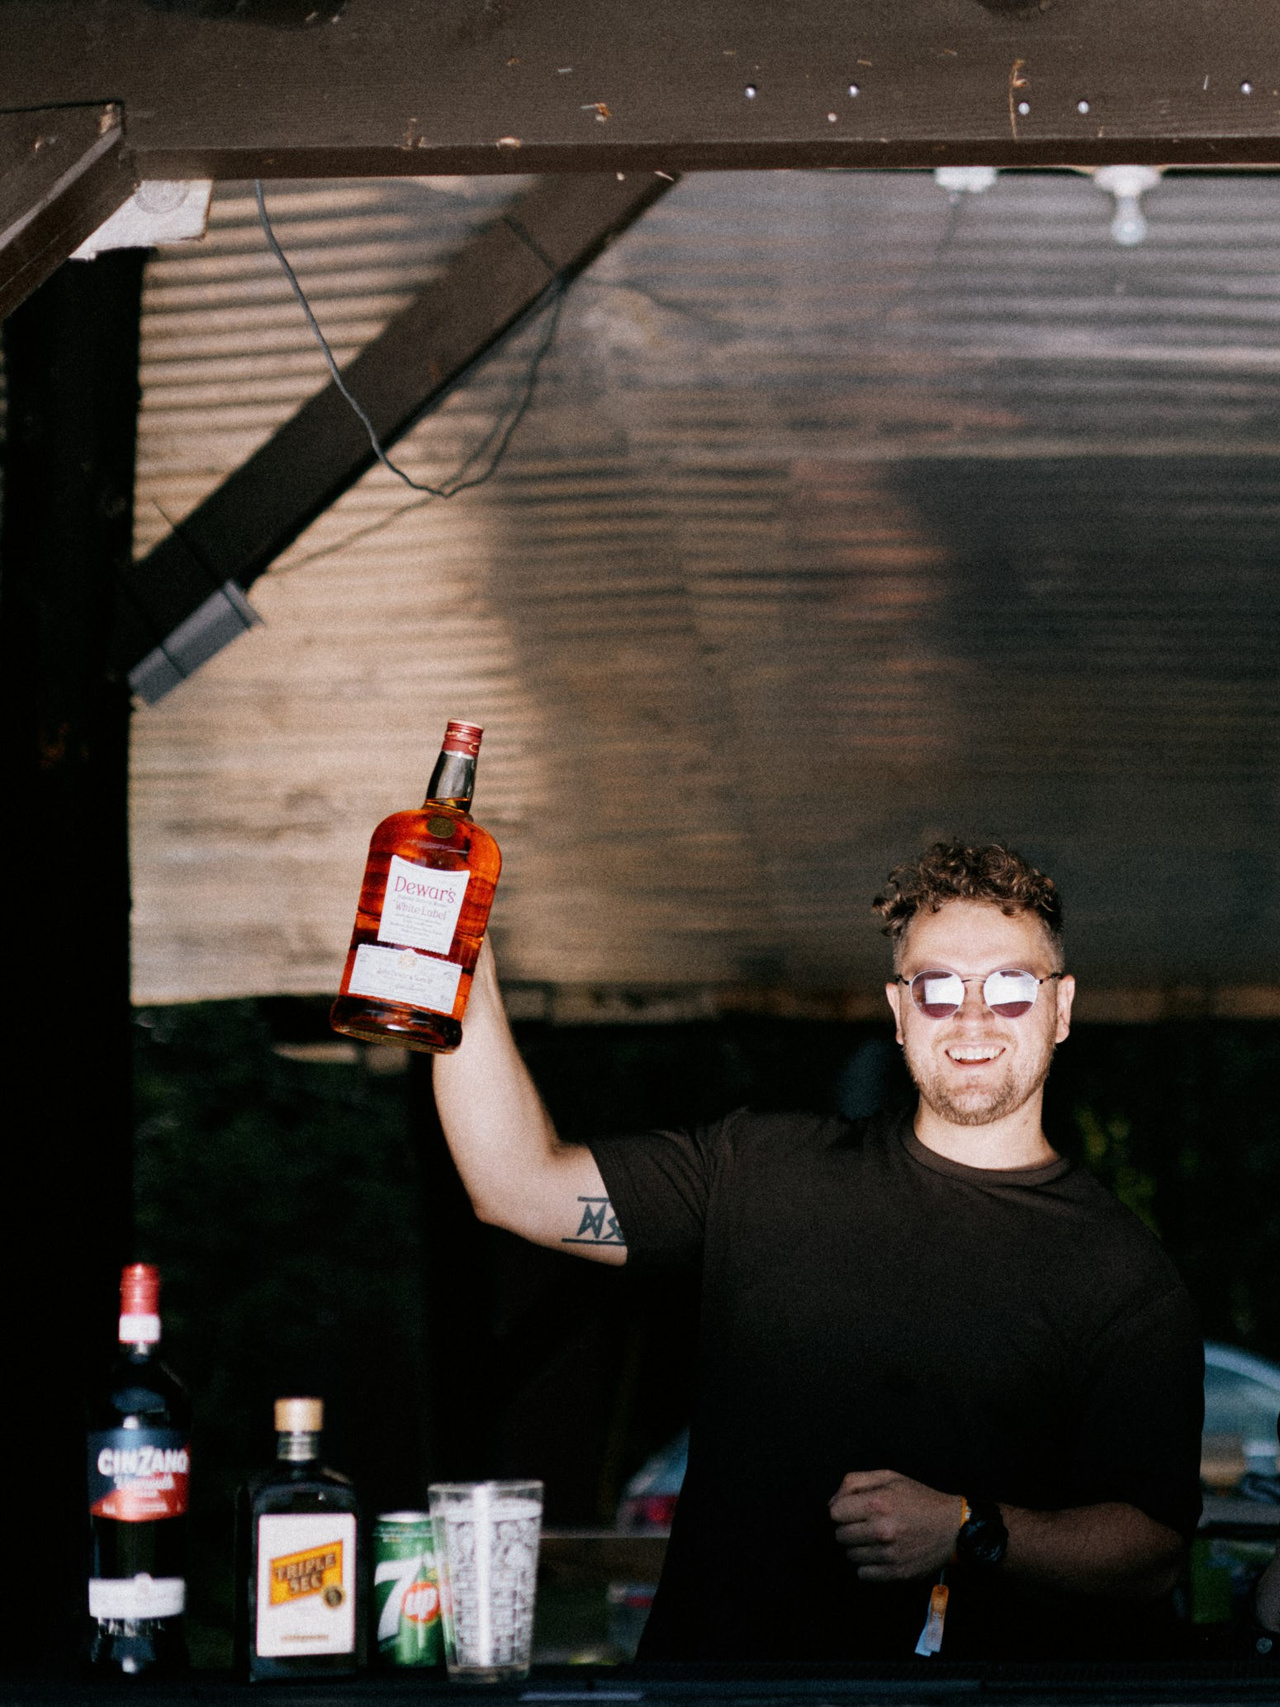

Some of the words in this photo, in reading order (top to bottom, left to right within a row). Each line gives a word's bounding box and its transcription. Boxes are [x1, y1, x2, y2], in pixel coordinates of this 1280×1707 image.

[394, 876, 457, 904] Dewar's
[97, 1445, 189, 1477] CINZANO
[276, 1553, 336, 1581] TRIPLE
[289, 1572, 323, 1594] SEC
